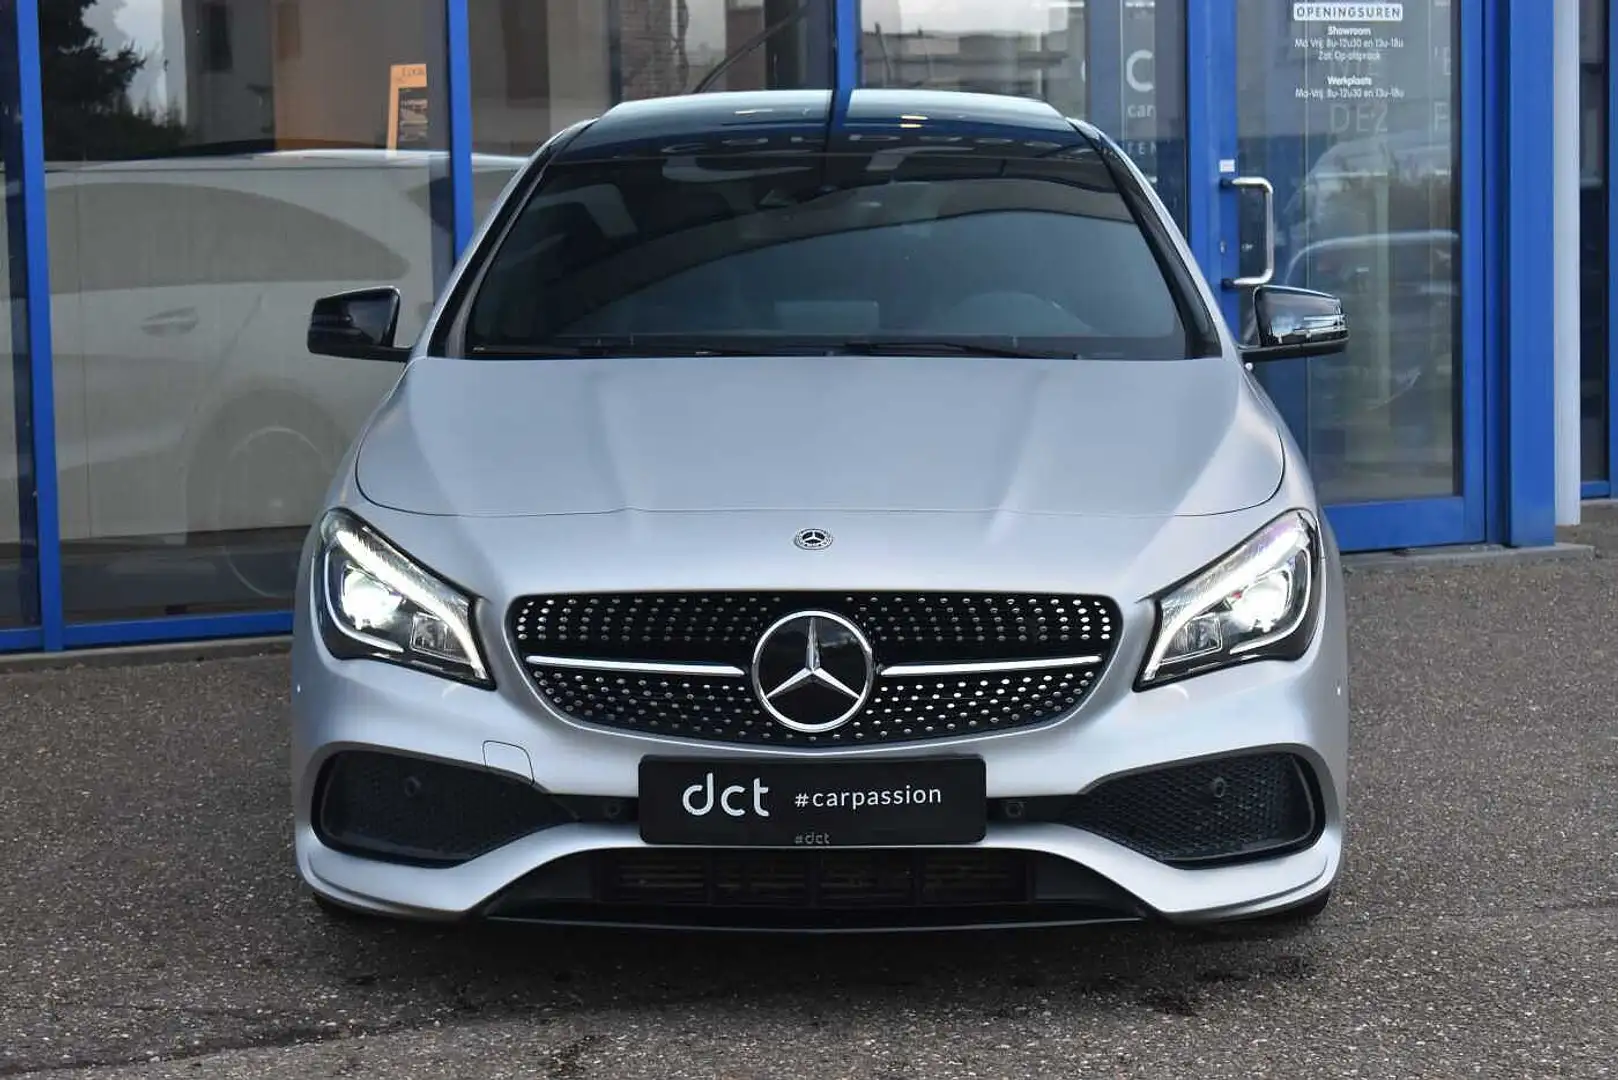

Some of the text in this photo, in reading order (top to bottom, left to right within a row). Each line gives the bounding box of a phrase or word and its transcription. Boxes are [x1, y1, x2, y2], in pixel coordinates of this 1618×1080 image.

[1296, 6, 1401, 18] OPENINGSUREN
[1327, 25, 1372, 36] Showroom
[1326, 75, 1373, 87] Werkplaats
[682, 772, 942, 817] dct #carpassion
[795, 832, 831, 845] #dct
